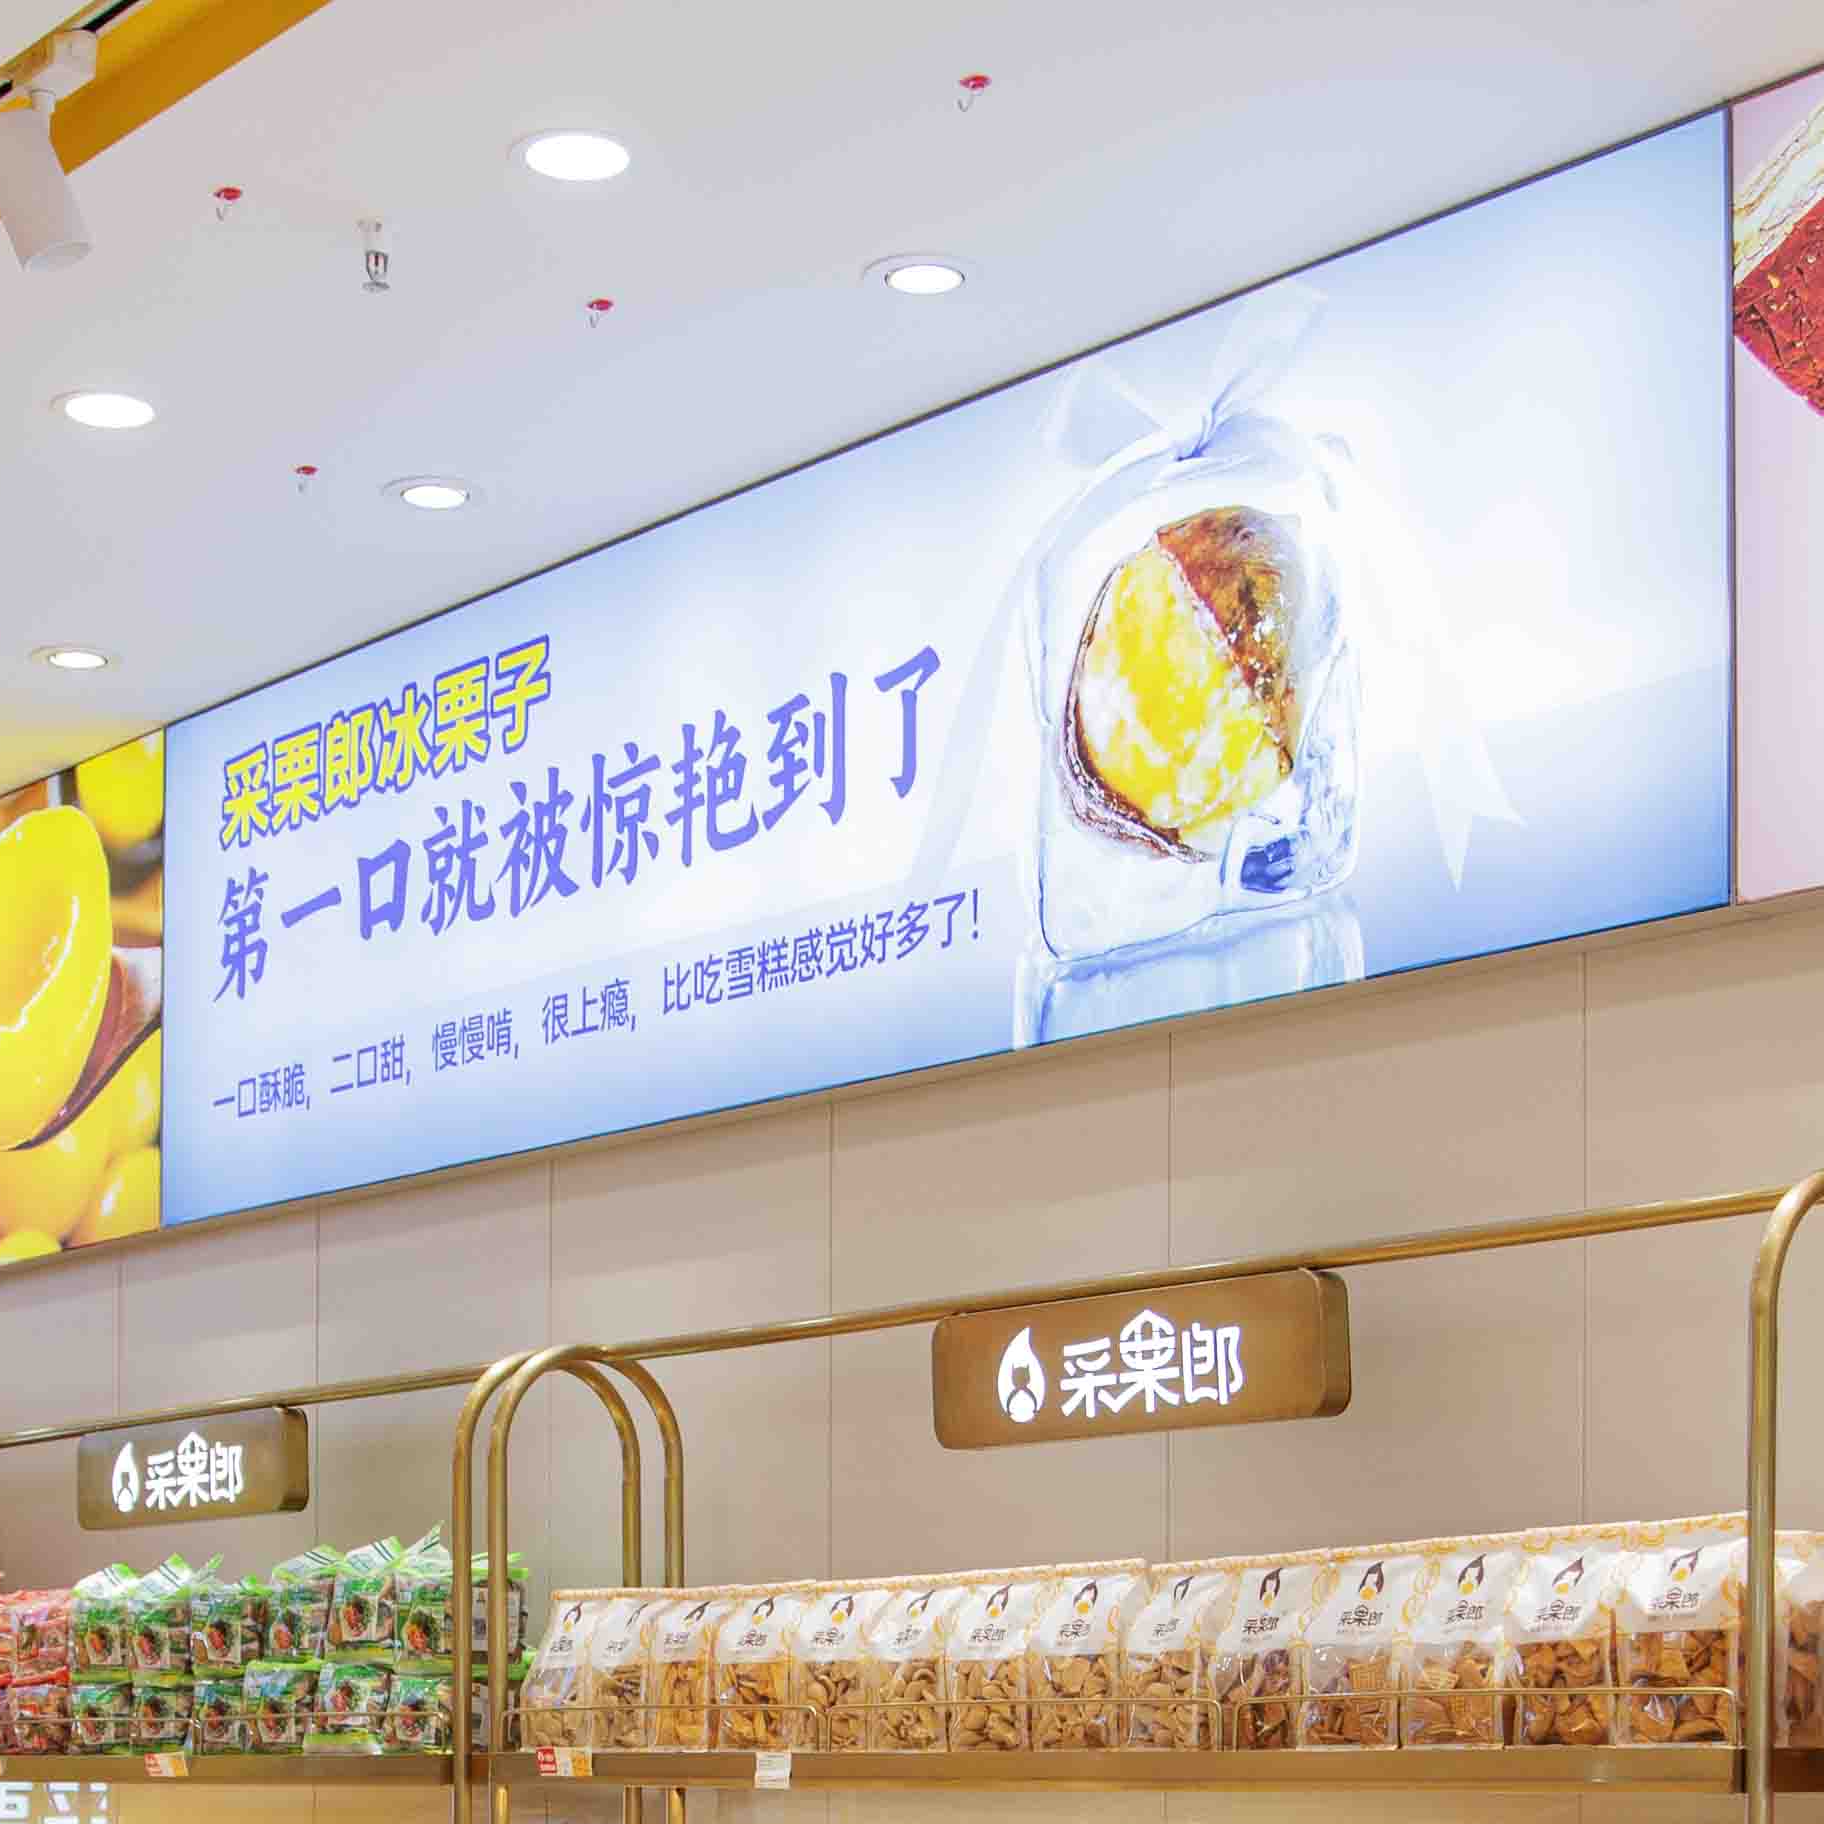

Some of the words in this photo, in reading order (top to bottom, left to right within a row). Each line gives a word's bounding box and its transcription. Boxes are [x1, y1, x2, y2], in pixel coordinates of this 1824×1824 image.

[220, 634, 552, 850] 采栗郎冰栗子
[212, 645, 941, 1004] 第一口就被惊艳到了
[1059, 1308, 1246, 1419] 采果郎
[144, 1430, 244, 1510] 采果郎
